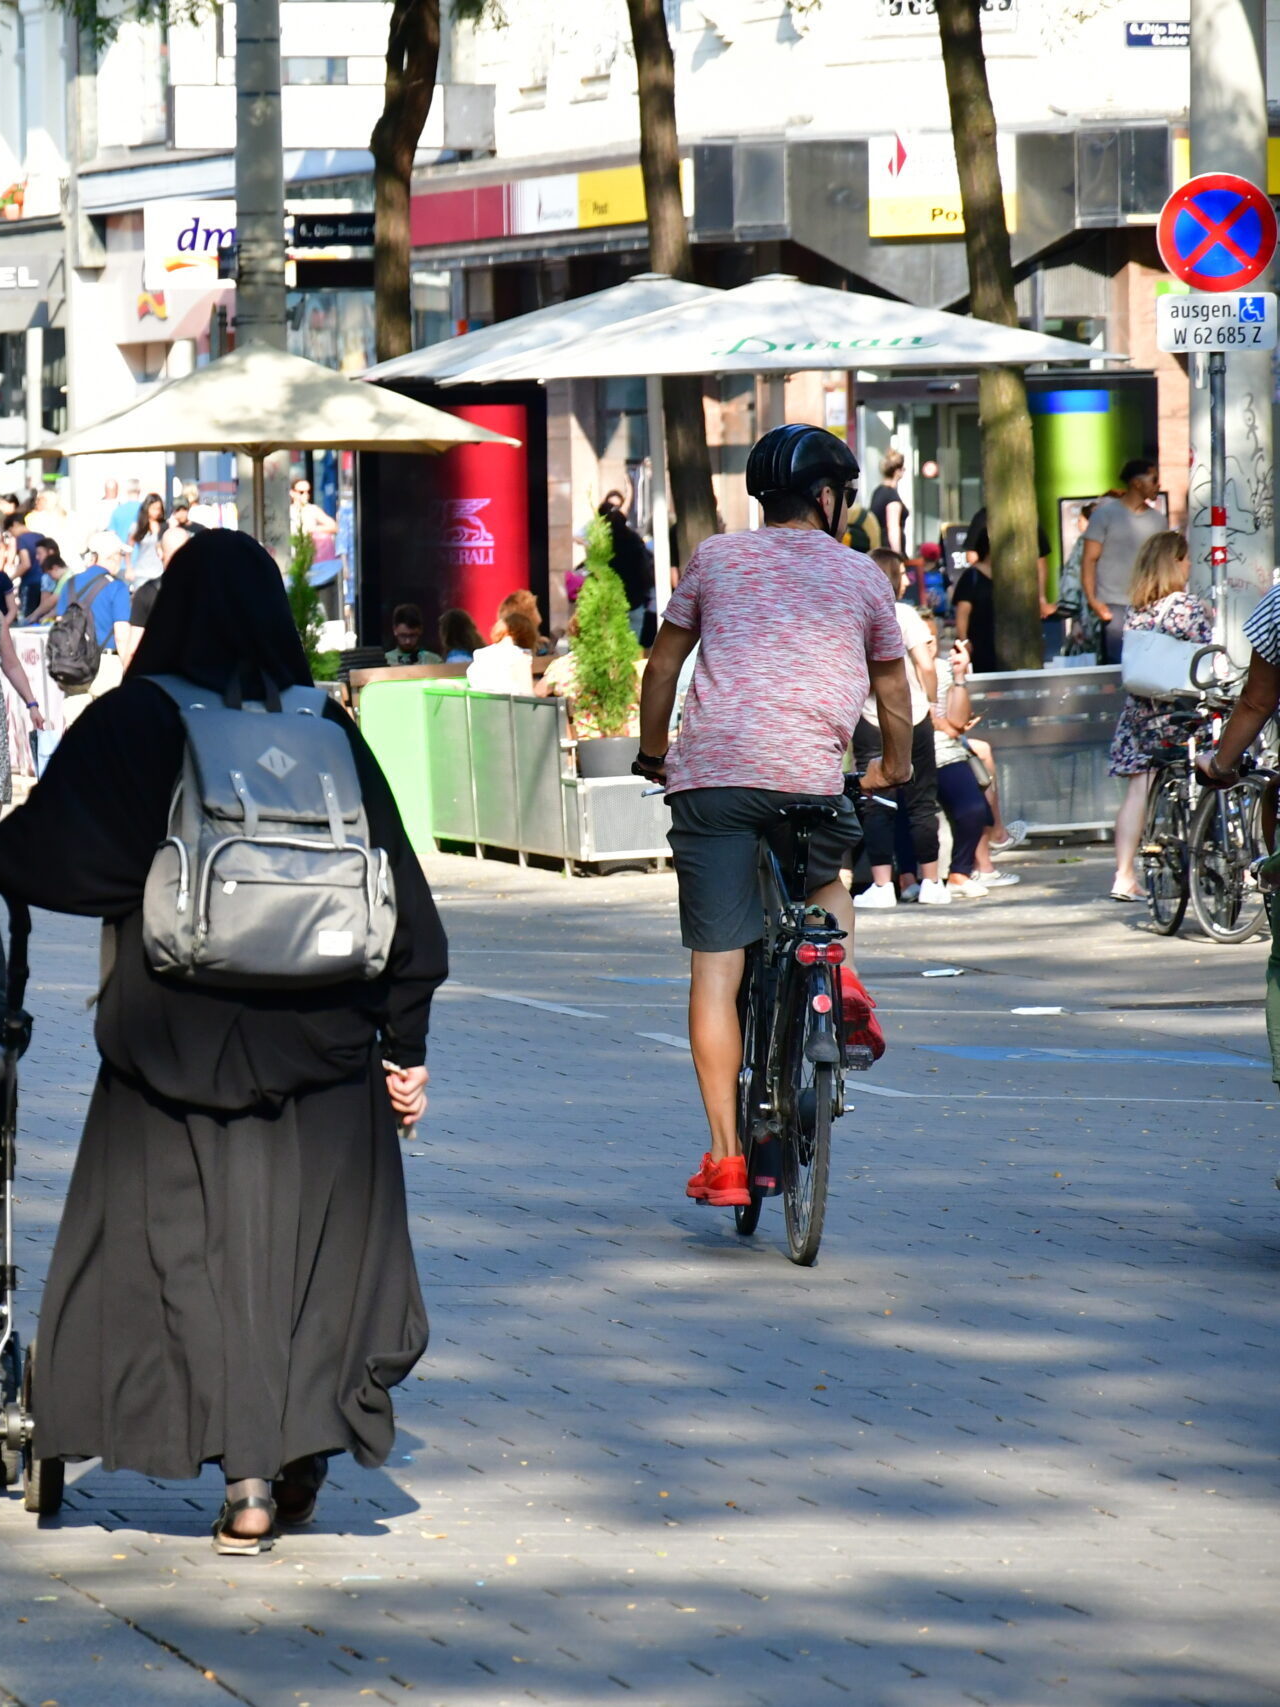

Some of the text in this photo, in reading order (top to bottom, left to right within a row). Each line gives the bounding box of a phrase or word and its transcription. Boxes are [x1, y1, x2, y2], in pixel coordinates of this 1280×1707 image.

[931, 207, 963, 222] Po
[177, 217, 237, 252] dm
[1170, 304, 1237, 322] ausgen.
[1173, 327, 1188, 345] W
[1252, 326, 1262, 343] Z
